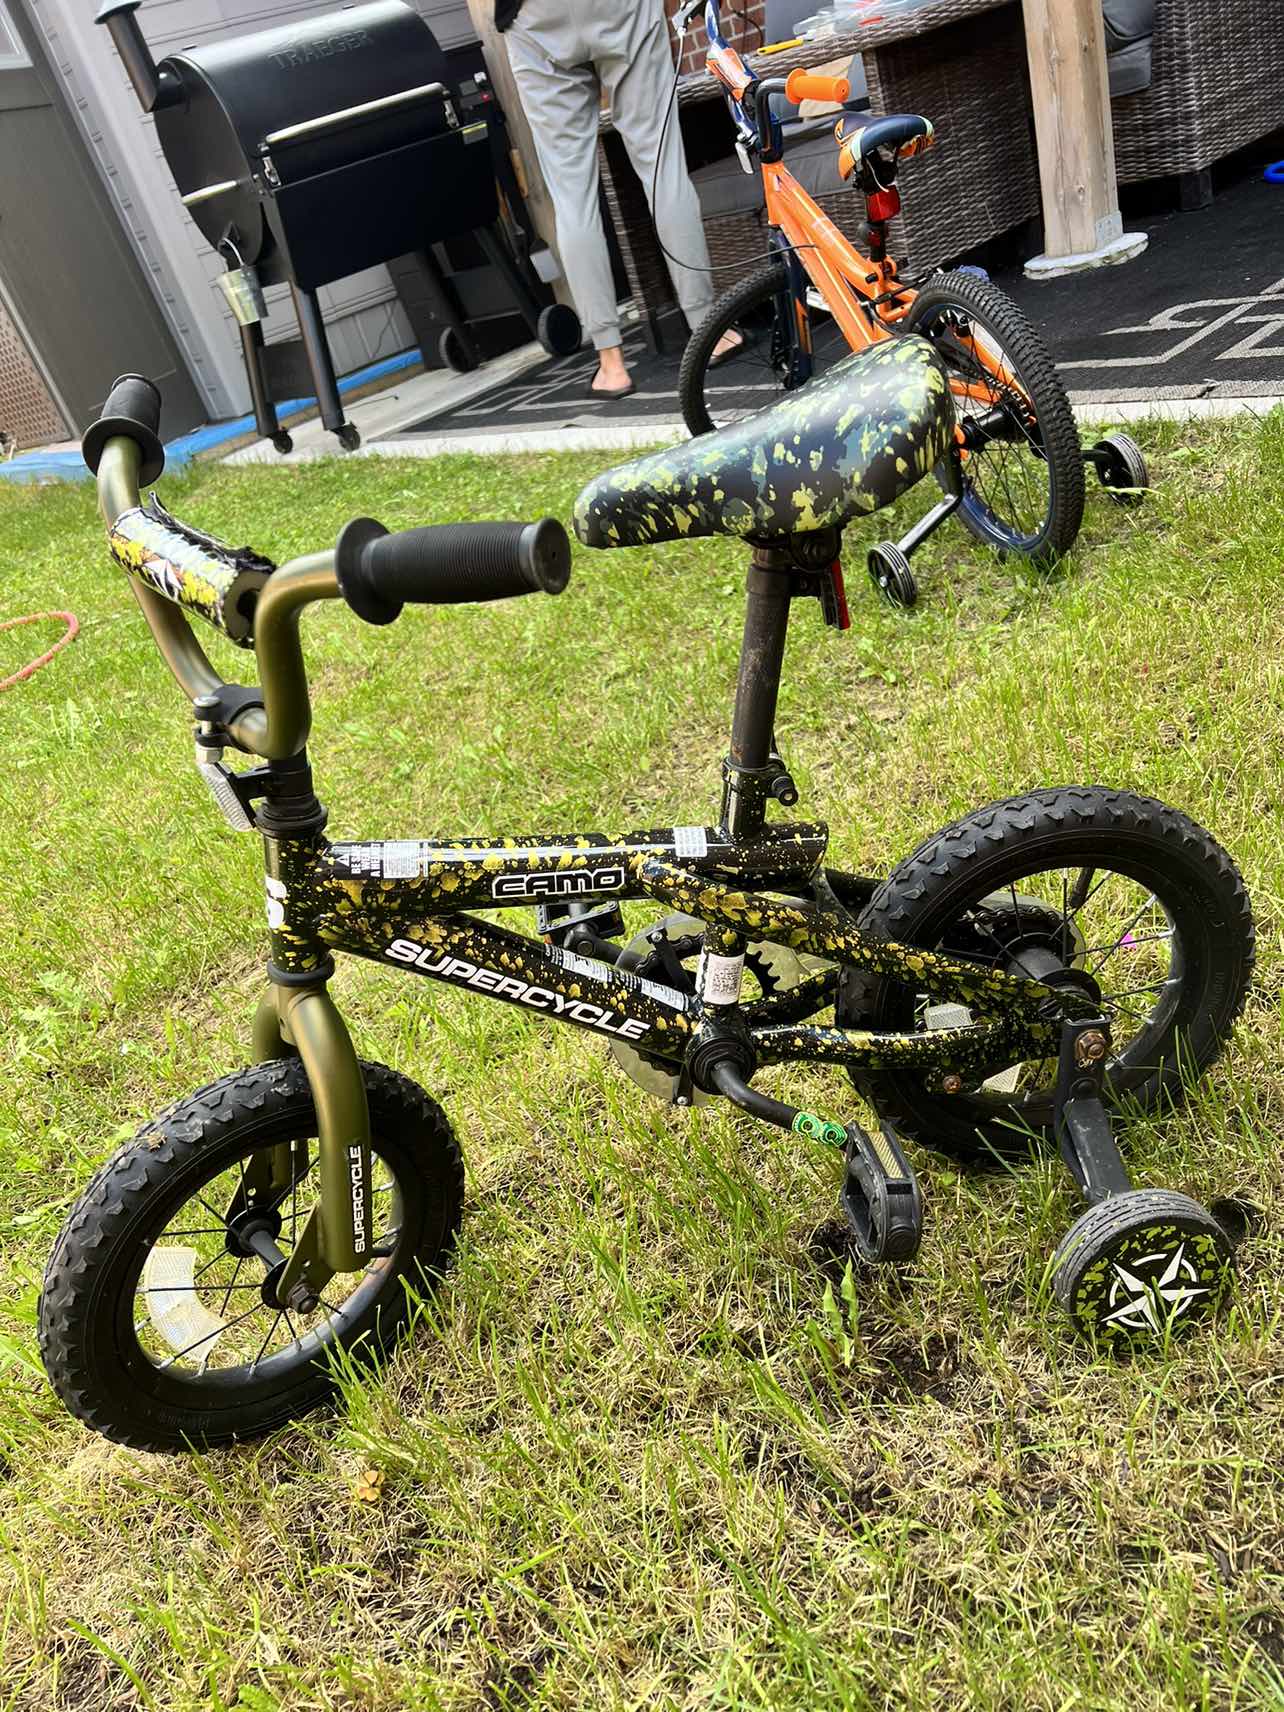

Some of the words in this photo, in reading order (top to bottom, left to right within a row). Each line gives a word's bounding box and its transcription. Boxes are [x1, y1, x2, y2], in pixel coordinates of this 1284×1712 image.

[266, 30, 374, 70] TRAEGER
[351, 844, 361, 862] SE
[361, 847, 371, 870] WE
[370, 843, 381, 870] HELET
[351, 863, 361, 874] BE
[491, 866, 625, 899] CAMO
[385, 938, 650, 1040] SUPERCYCLE
[349, 1145, 366, 1253] SUPERCYCLE
